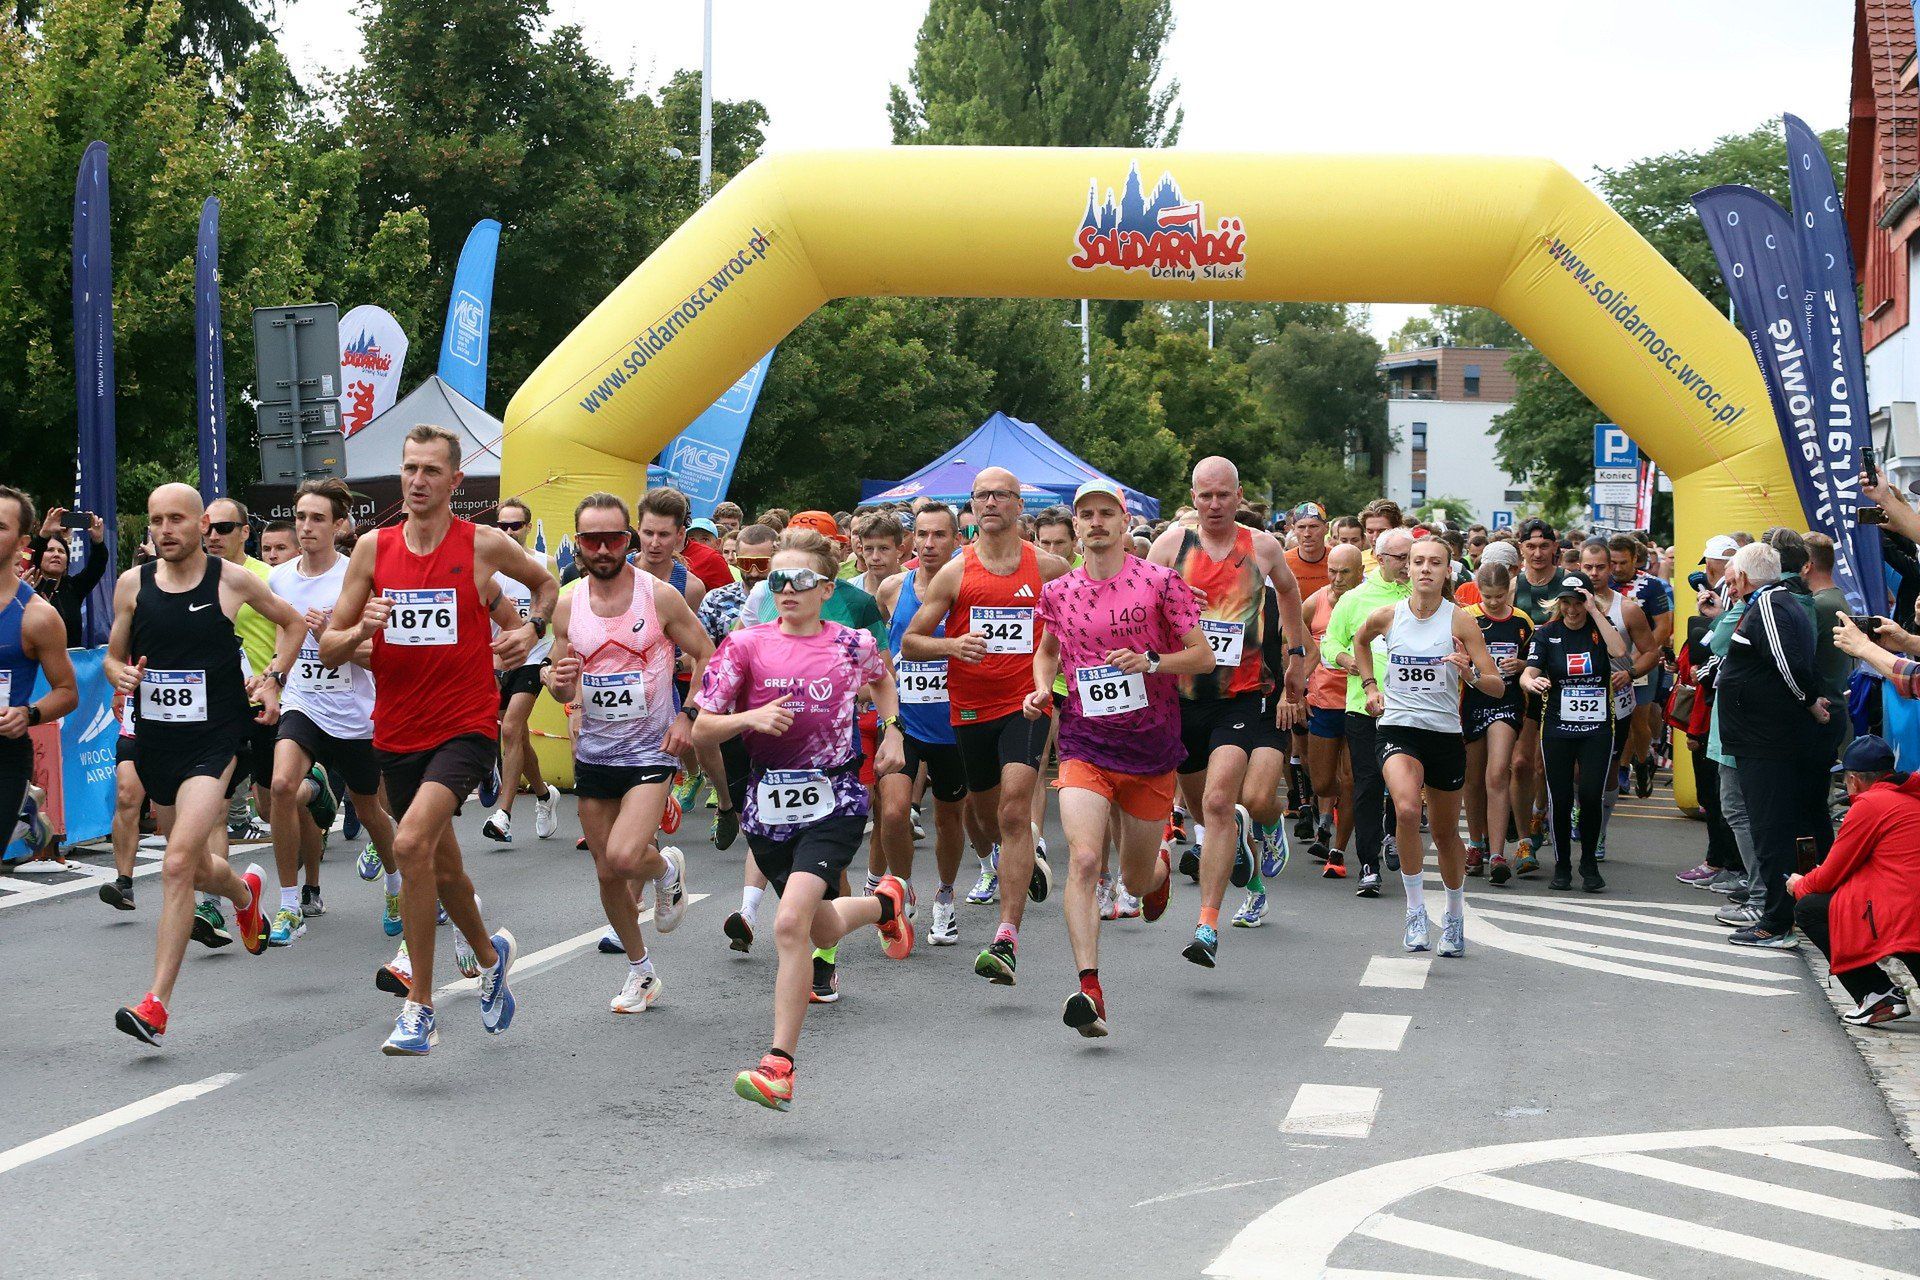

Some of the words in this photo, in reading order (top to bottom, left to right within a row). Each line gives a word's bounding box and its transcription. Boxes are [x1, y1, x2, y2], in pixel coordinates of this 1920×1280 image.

[1152, 265, 1195, 281] Dolny
[579, 227, 771, 414] www.solidarnosc.wroc.pl
[1549, 238, 1745, 426] www.solidarnosc.wroc.pl
[1605, 429, 1629, 462] P
[1600, 471, 1632, 480] Koniec
[391, 609, 451, 629] 1876
[982, 624, 1022, 639] 342
[1111, 625, 1149, 637] MINUT
[1208, 636, 1232, 652] 37
[302, 664, 339, 679] 372
[1398, 668, 1436, 681] 386
[764, 677, 805, 687] GREAT
[151, 688, 193, 707] 488
[592, 690, 634, 707] 424
[779, 687, 805, 696] MAN
[1090, 680, 1131, 702] 681
[1569, 700, 1599, 712] 352
[768, 787, 820, 808] 126
